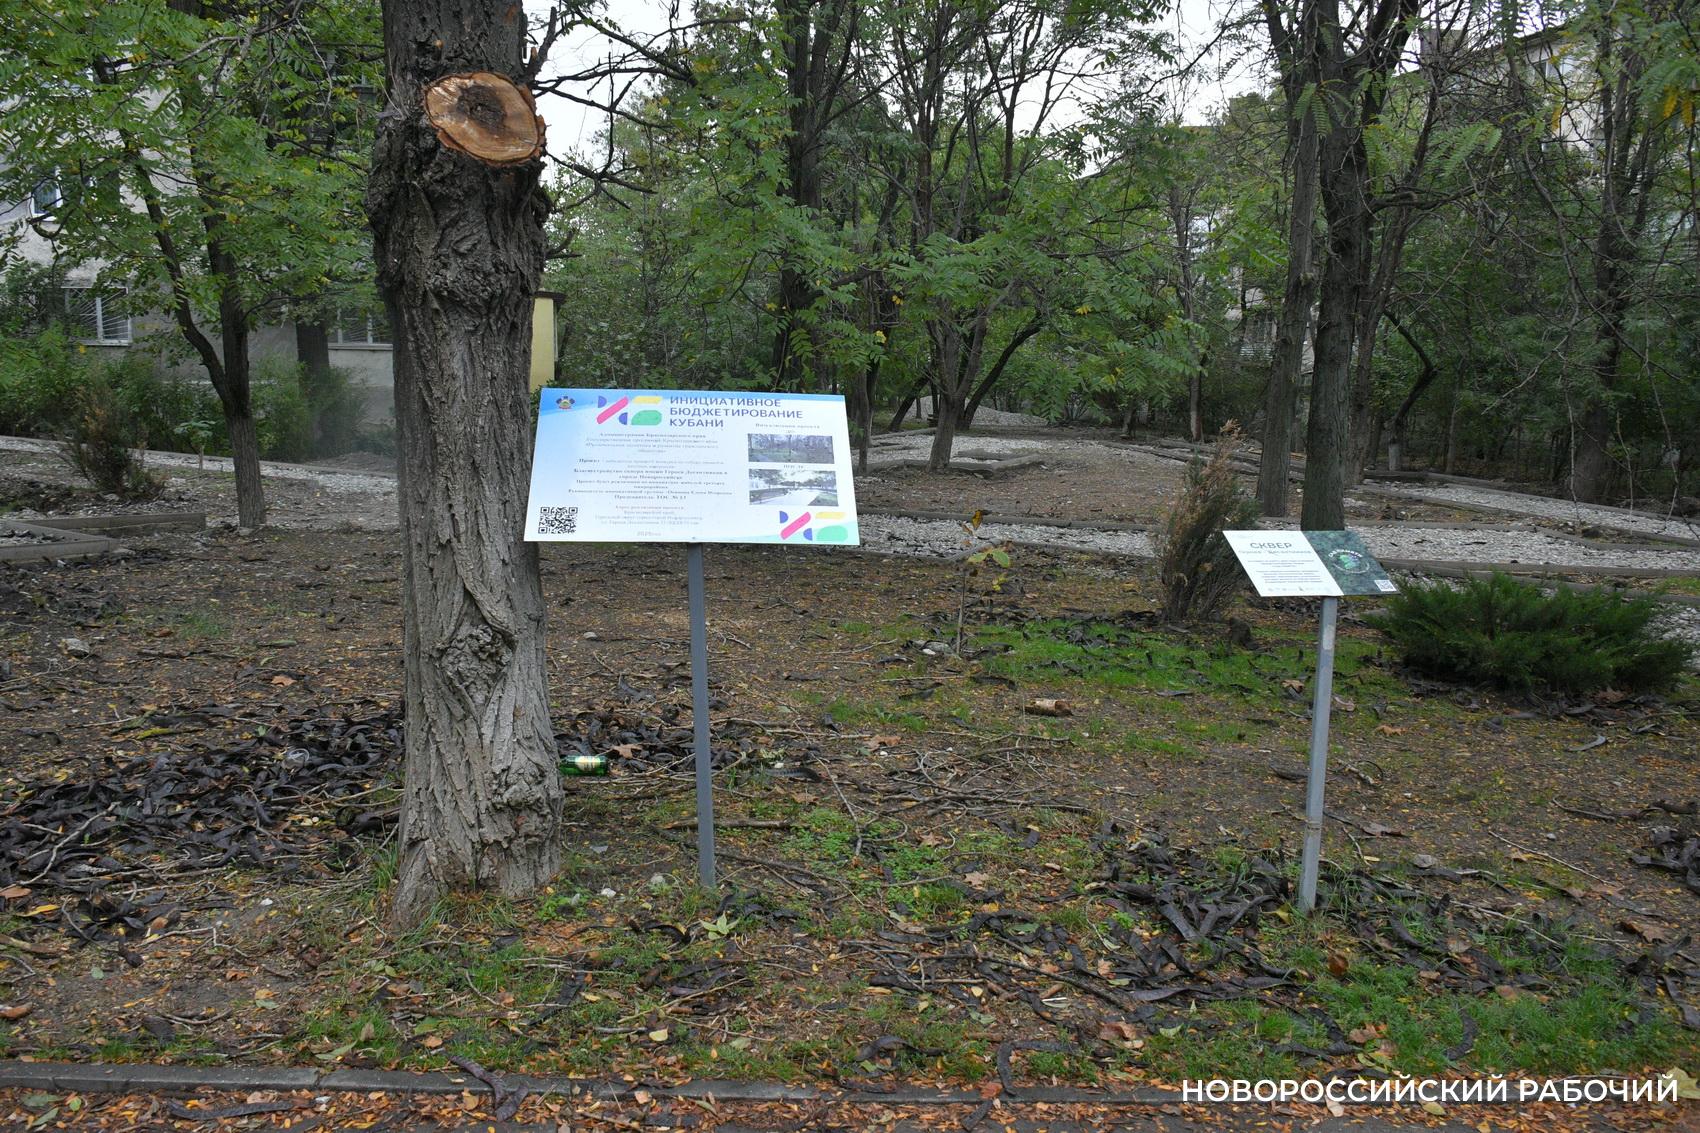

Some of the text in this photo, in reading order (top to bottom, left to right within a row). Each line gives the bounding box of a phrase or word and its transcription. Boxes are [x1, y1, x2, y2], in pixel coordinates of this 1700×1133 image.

[669, 396, 782, 407] ИНИЦИАТИВНОЕ
[669, 407, 804, 419] БЮДЖЕТИРОВАНИЕ
[669, 418, 725, 428] КУБАНИ
